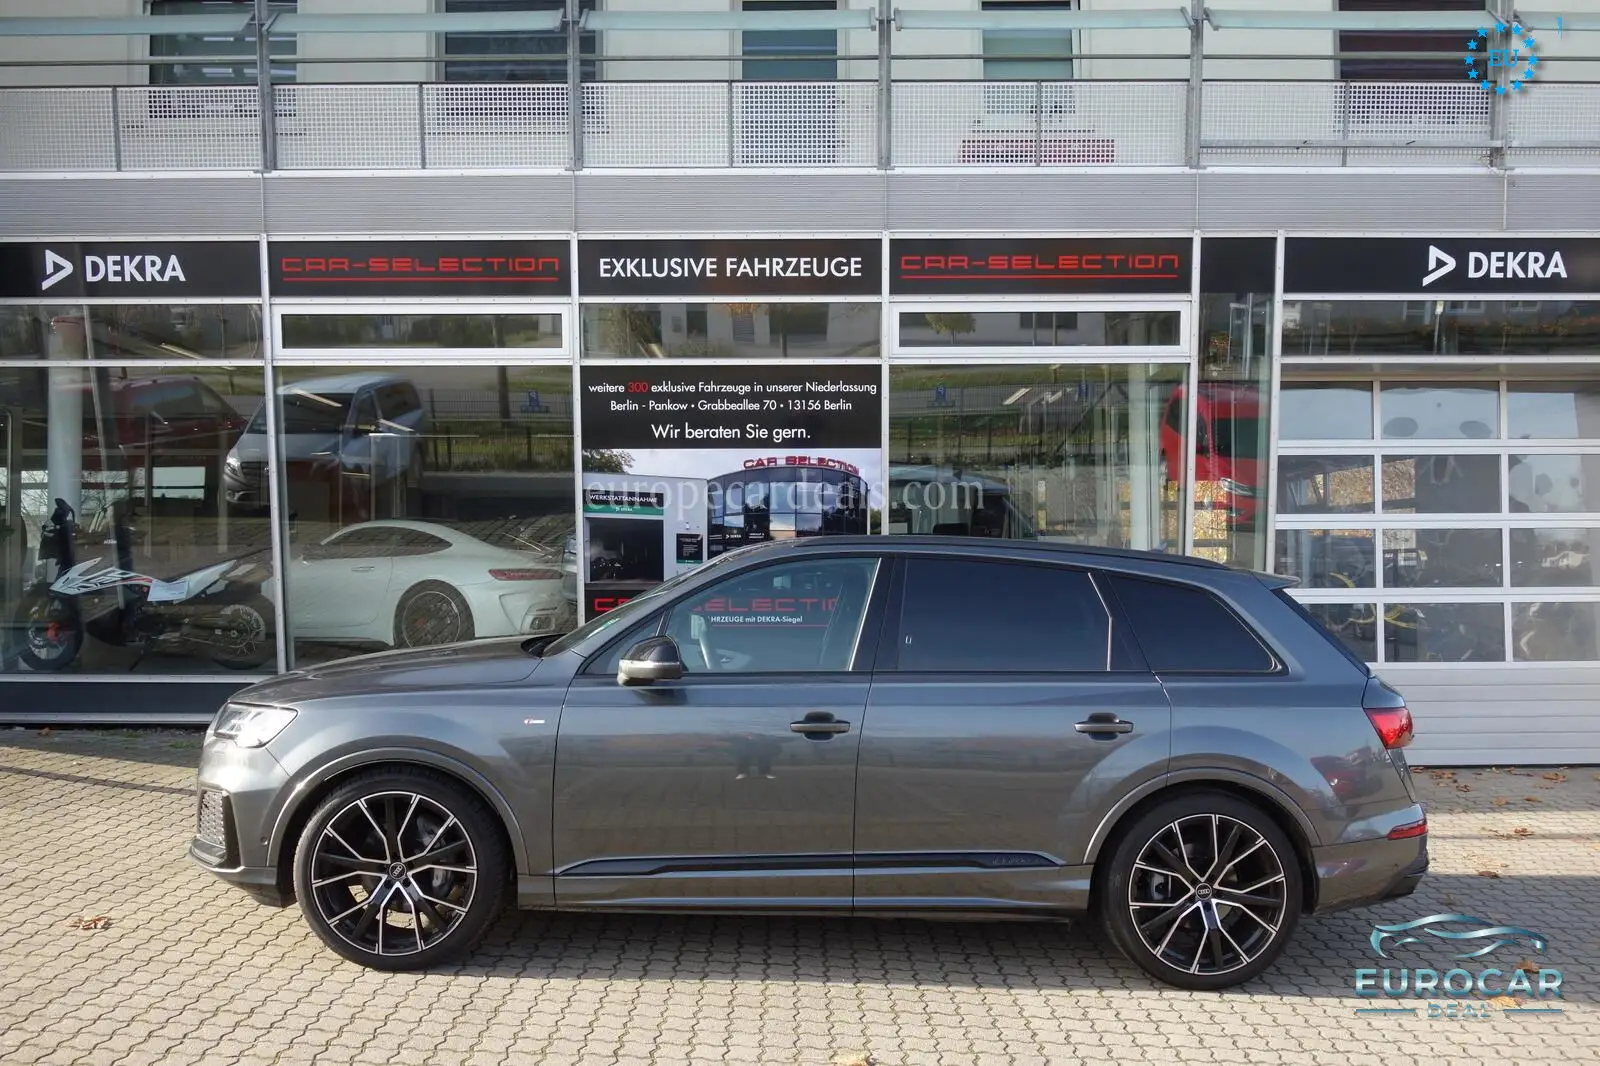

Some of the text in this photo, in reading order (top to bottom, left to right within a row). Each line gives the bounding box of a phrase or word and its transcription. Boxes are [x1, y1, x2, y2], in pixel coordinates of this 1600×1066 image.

[85, 254, 187, 282] DEKRA
[281, 257, 559, 272] CAR-SELECTION
[599, 256, 862, 278] EXKLUSIVE FAHRZEUGE
[901, 255, 1179, 270] CAR-SELECTION
[1468, 250, 1568, 279] DEKRA
[588, 380, 877, 395] weitere 300 exklusive Fahrzeuge in unserer Niederlassung
[610, 399, 639, 411] Berlin
[649, 399, 688, 411] Pankow
[697, 399, 760, 411] Grabbeallee
[763, 400, 777, 411] 70
[788, 400, 821, 411] 13156
[824, 399, 852, 411] Berlin
[651, 421, 811, 443] Wir beraten Sie gern.
[743, 456, 860, 476] CAR SELECTION
[589, 493, 657, 503] WERKSTATTANNAHME
[708, 615, 803, 624] HRZEUGE mit DEKRA-Siegel
